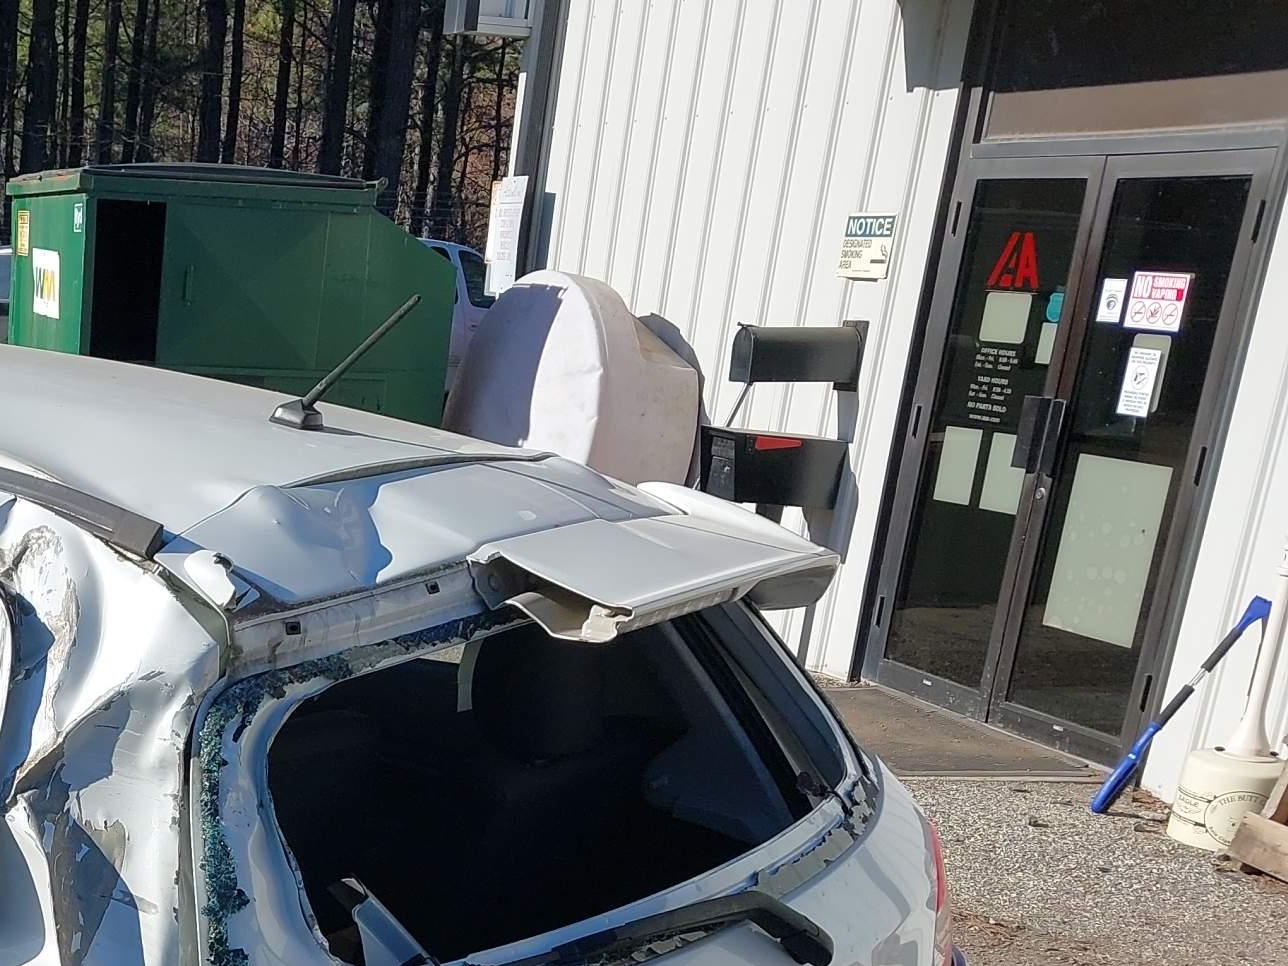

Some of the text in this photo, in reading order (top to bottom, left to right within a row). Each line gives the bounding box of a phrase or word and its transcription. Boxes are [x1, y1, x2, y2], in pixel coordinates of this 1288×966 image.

[847, 217, 894, 236] NOTICE
[842, 239, 872, 249] DESIGNATED
[840, 249, 863, 259] SMOKING
[838, 259, 853, 270] AREA
[1133, 275, 1186, 298] NO SMOKING
[980, 347, 1016, 357] OFFICE HOURS
[1218, 796, 1236, 806] THE
